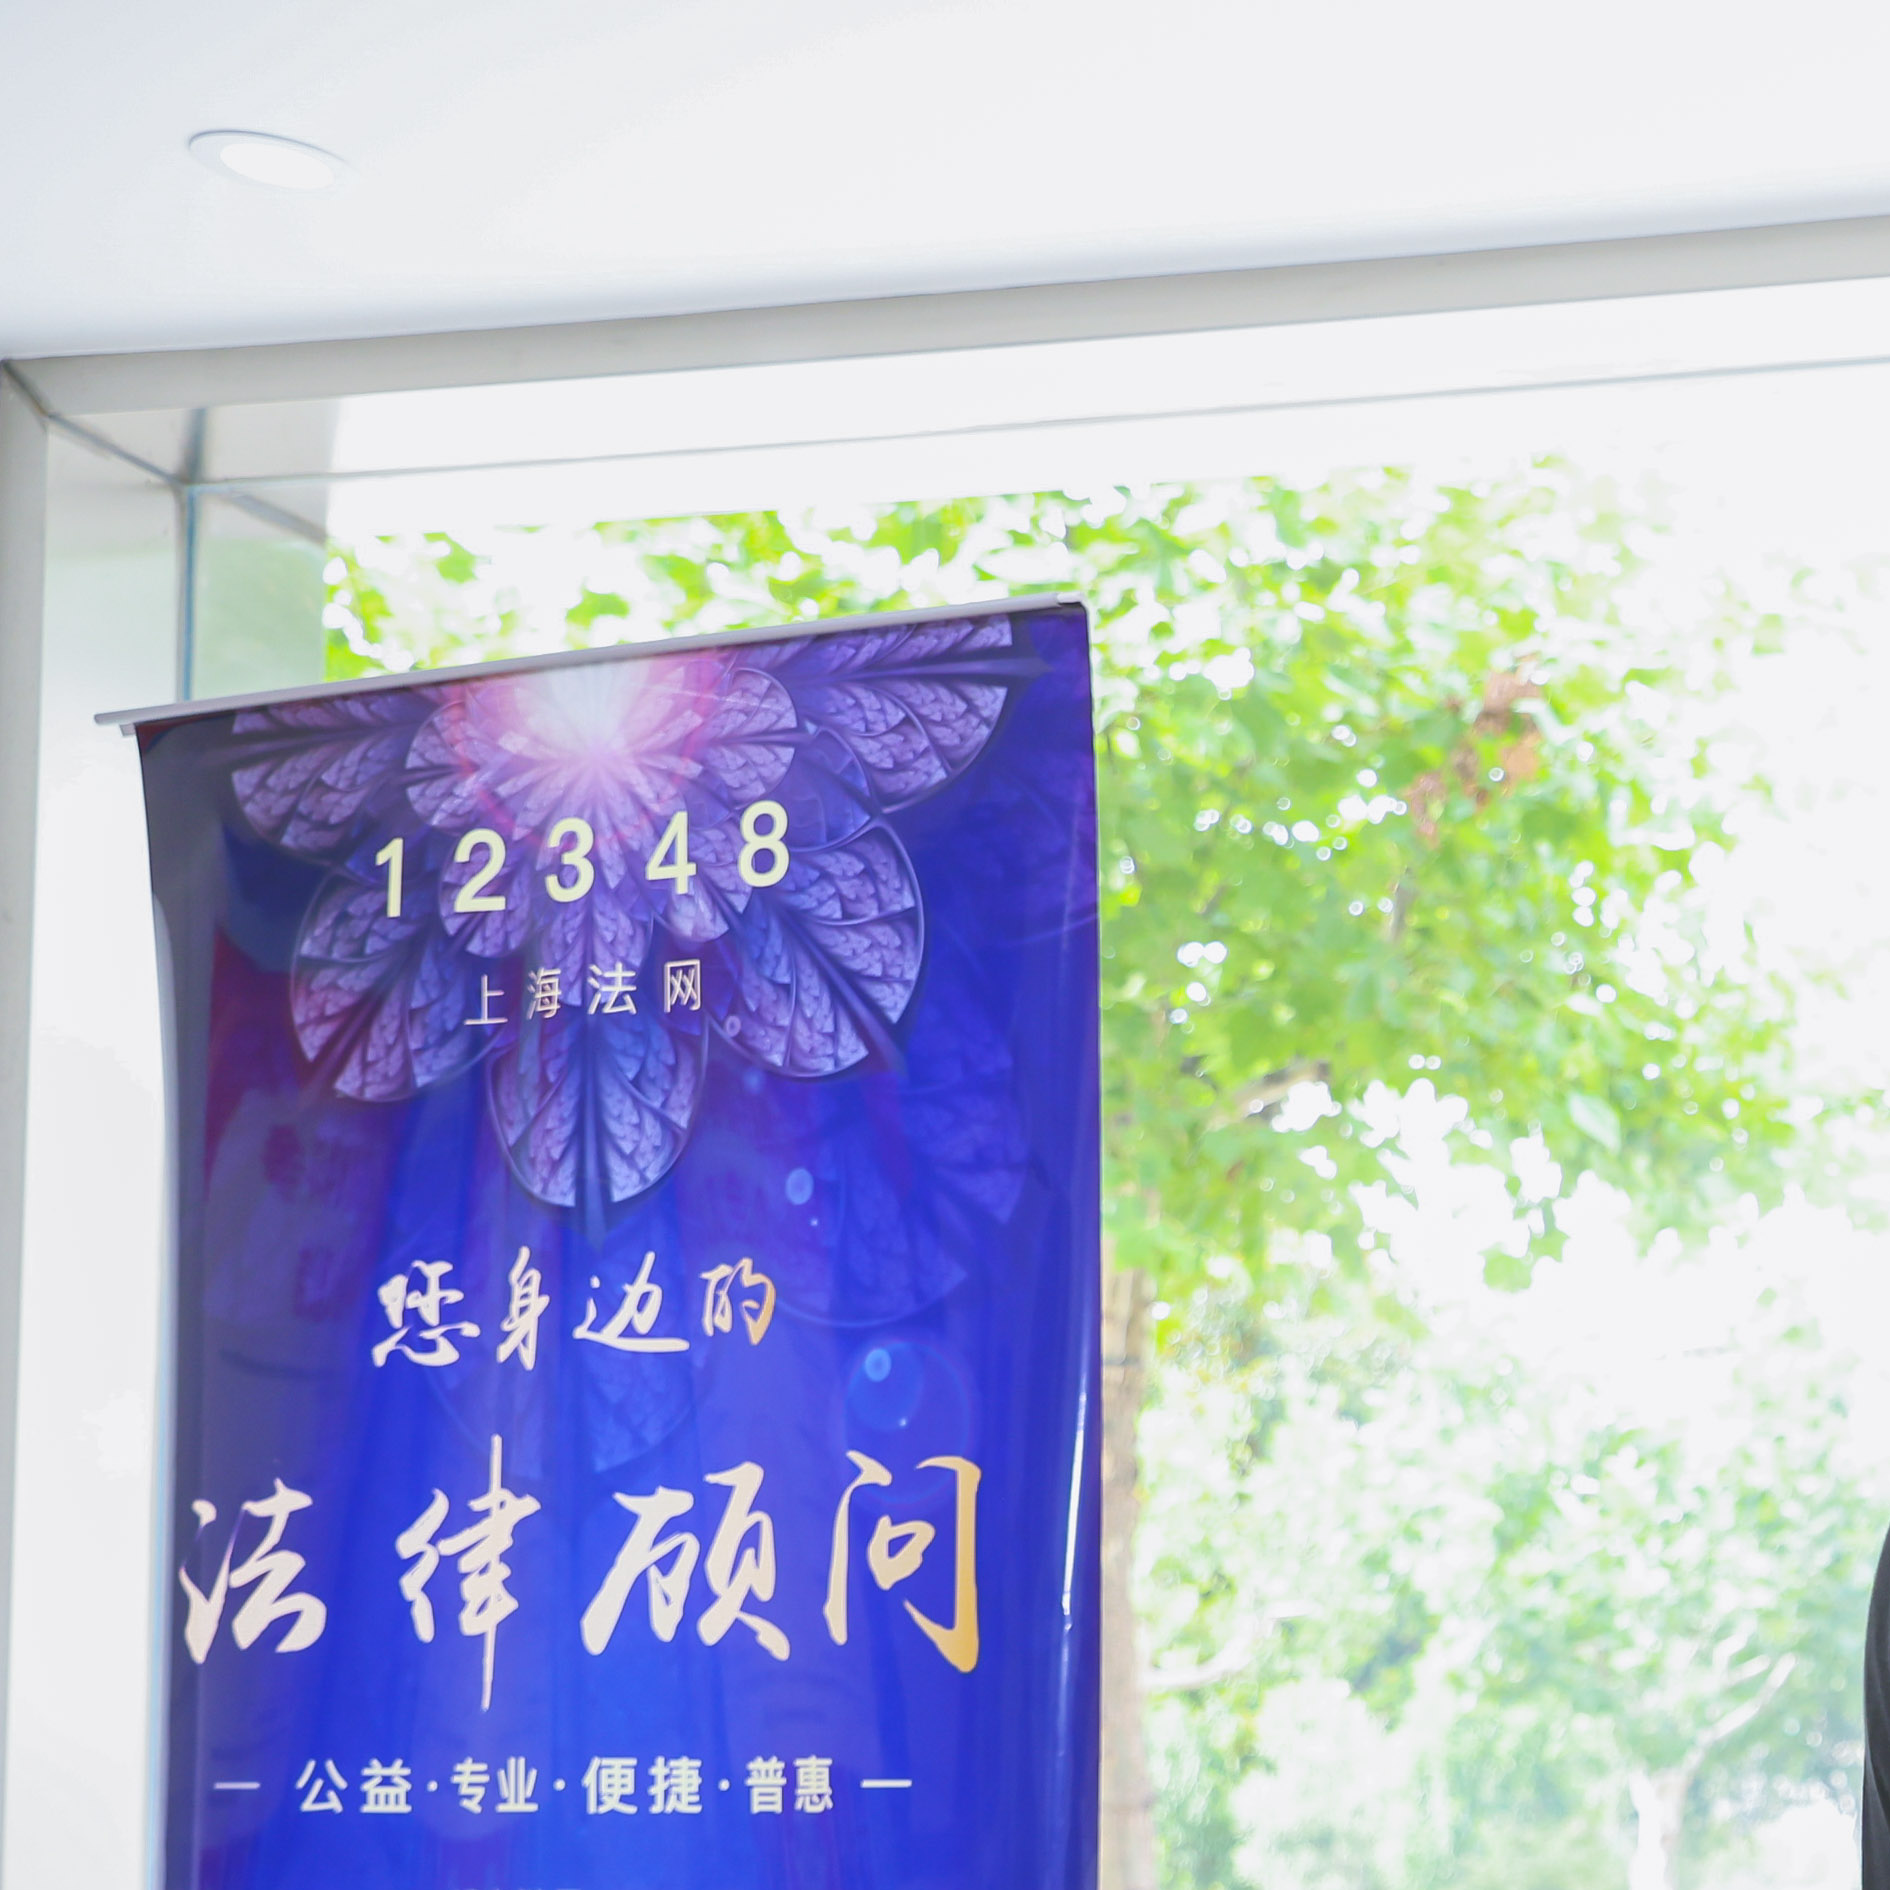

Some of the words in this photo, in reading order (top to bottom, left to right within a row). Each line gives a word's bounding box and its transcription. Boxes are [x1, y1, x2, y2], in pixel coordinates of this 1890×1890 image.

[375, 800, 790, 918] 12348
[464, 958, 704, 1029] 上海法网
[371, 1245, 776, 1371] 您身边的
[180, 1434, 982, 1712] 法律顾问
